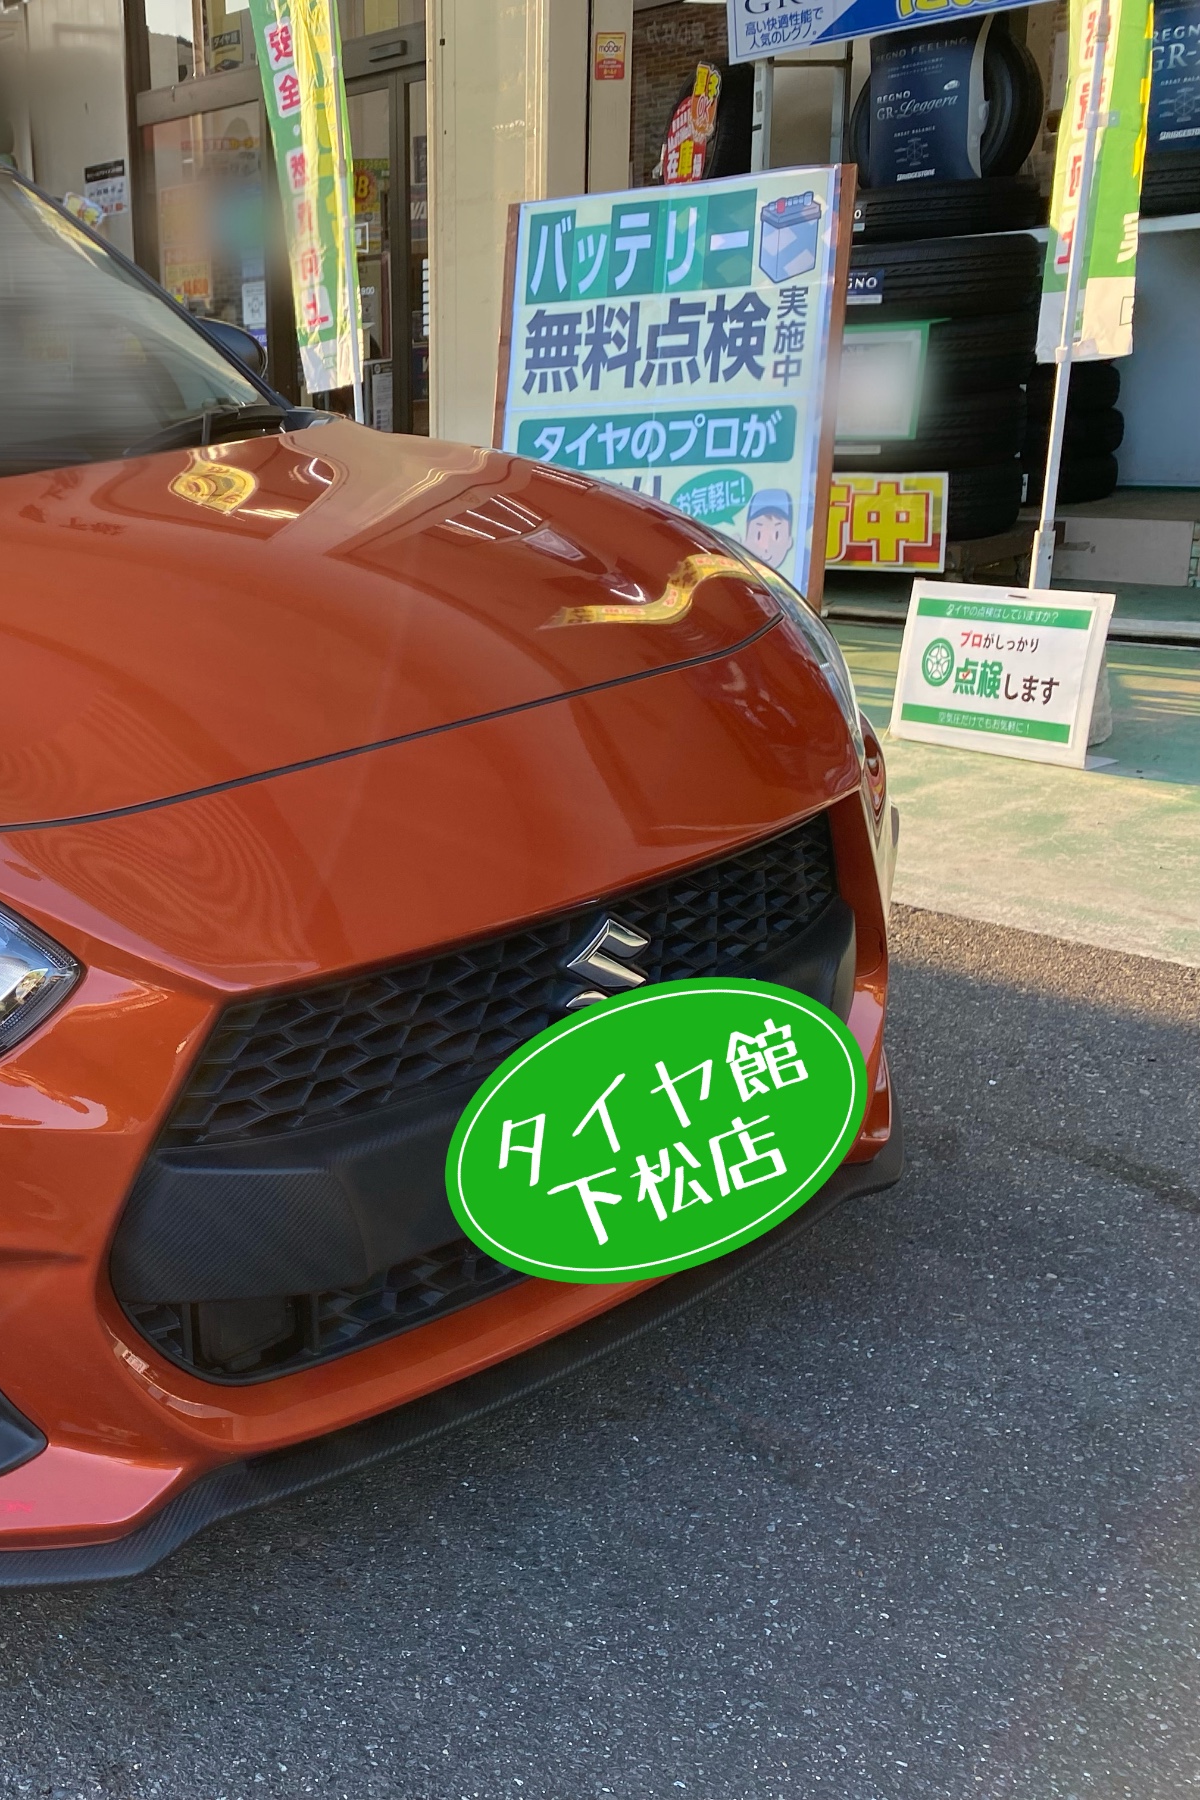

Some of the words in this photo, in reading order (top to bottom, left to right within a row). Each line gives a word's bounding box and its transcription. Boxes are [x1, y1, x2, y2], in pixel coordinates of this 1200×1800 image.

[745, 7, 824, 36] 高い快適性能で
[910, 36, 969, 55] FEELING
[876, 90, 911, 104] REGNO
[896, 168, 936, 182] BRIDGESTONE
[529, 206, 750, 297] バッテリー
[522, 290, 771, 395] 無料点検
[771, 285, 809, 388] 実施中
[533, 410, 784, 466] タイヤのプロが
[945, 603, 1060, 624] タイヤの点検はしていますか？
[960, 630, 1040, 653] プロがしっかり
[952, 657, 1060, 706] 点検します
[938, 711, 1031, 735] 空気圧だけでもお気軽に！
